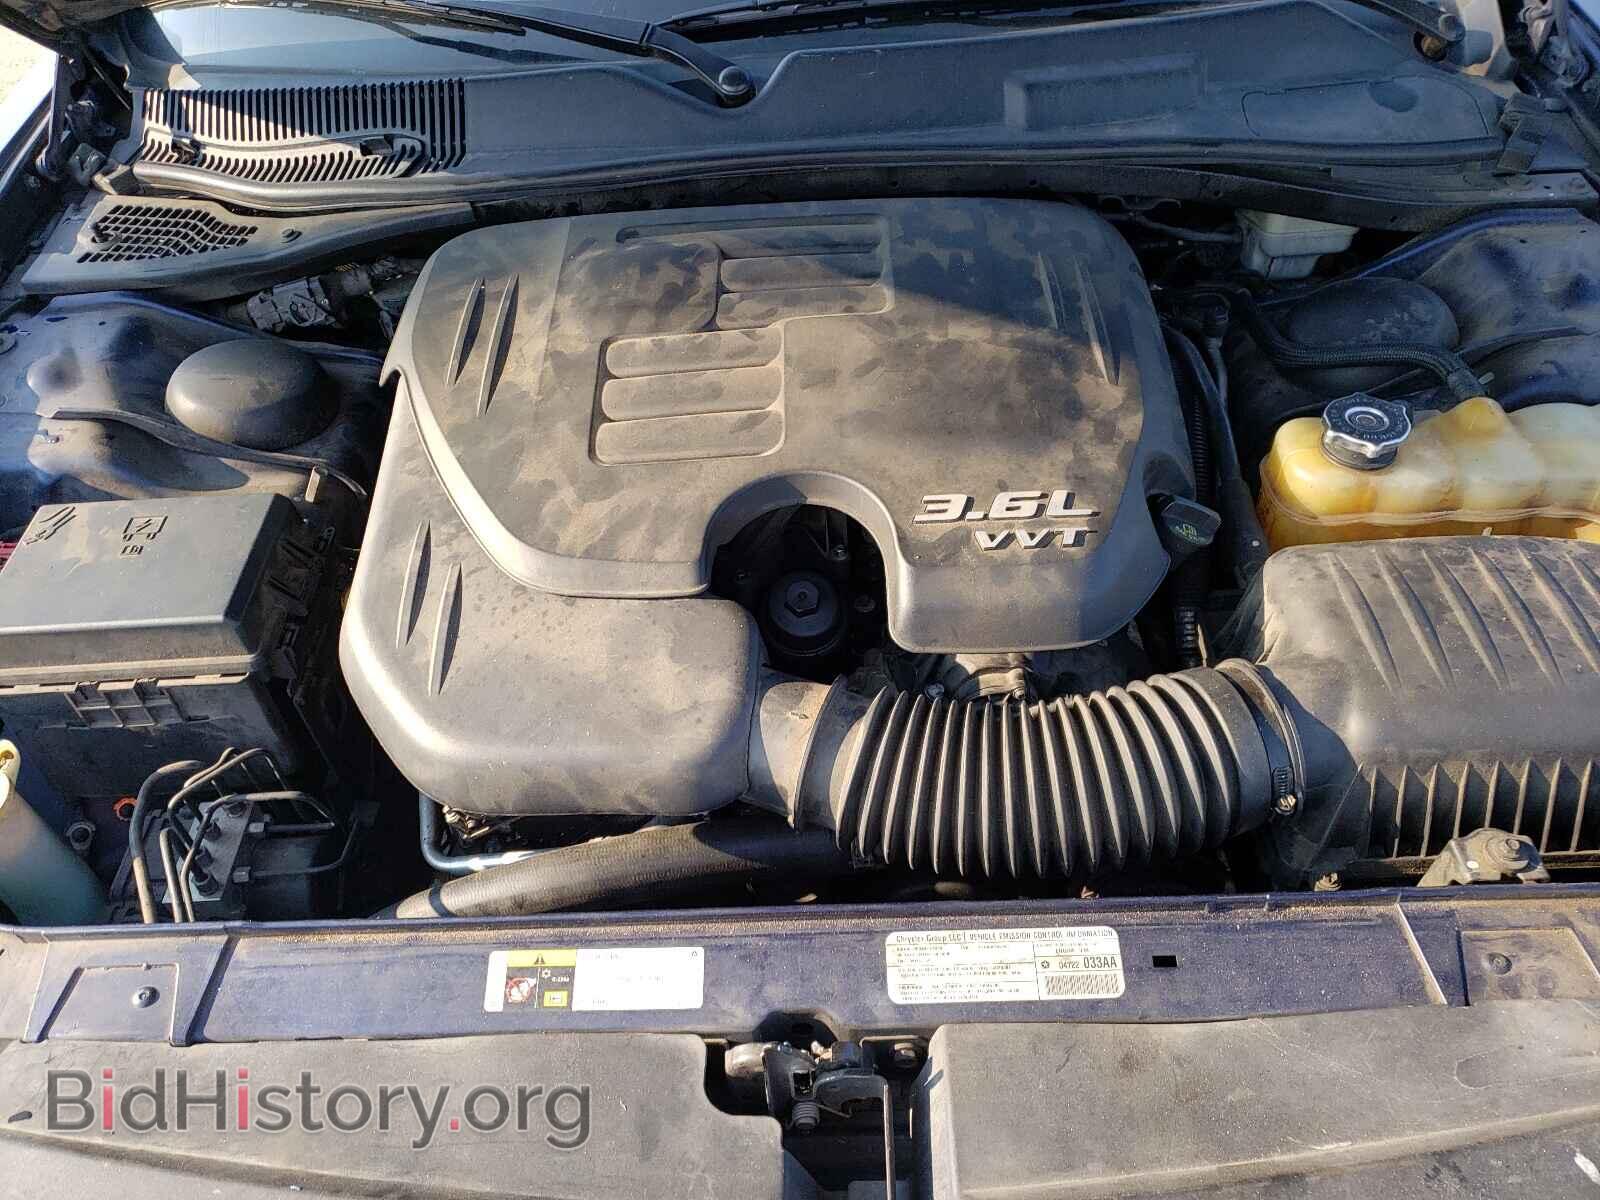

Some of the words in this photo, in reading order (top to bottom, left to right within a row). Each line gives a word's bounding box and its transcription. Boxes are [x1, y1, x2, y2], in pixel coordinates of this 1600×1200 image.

[913, 490, 1101, 524] 3.6L
[974, 528, 1097, 551] VVT
[926, 935, 947, 943] Group
[969, 933, 997, 941] VEHICLE
[999, 932, 1031, 940] EMISSION
[1083, 956, 1118, 968] 033AA
